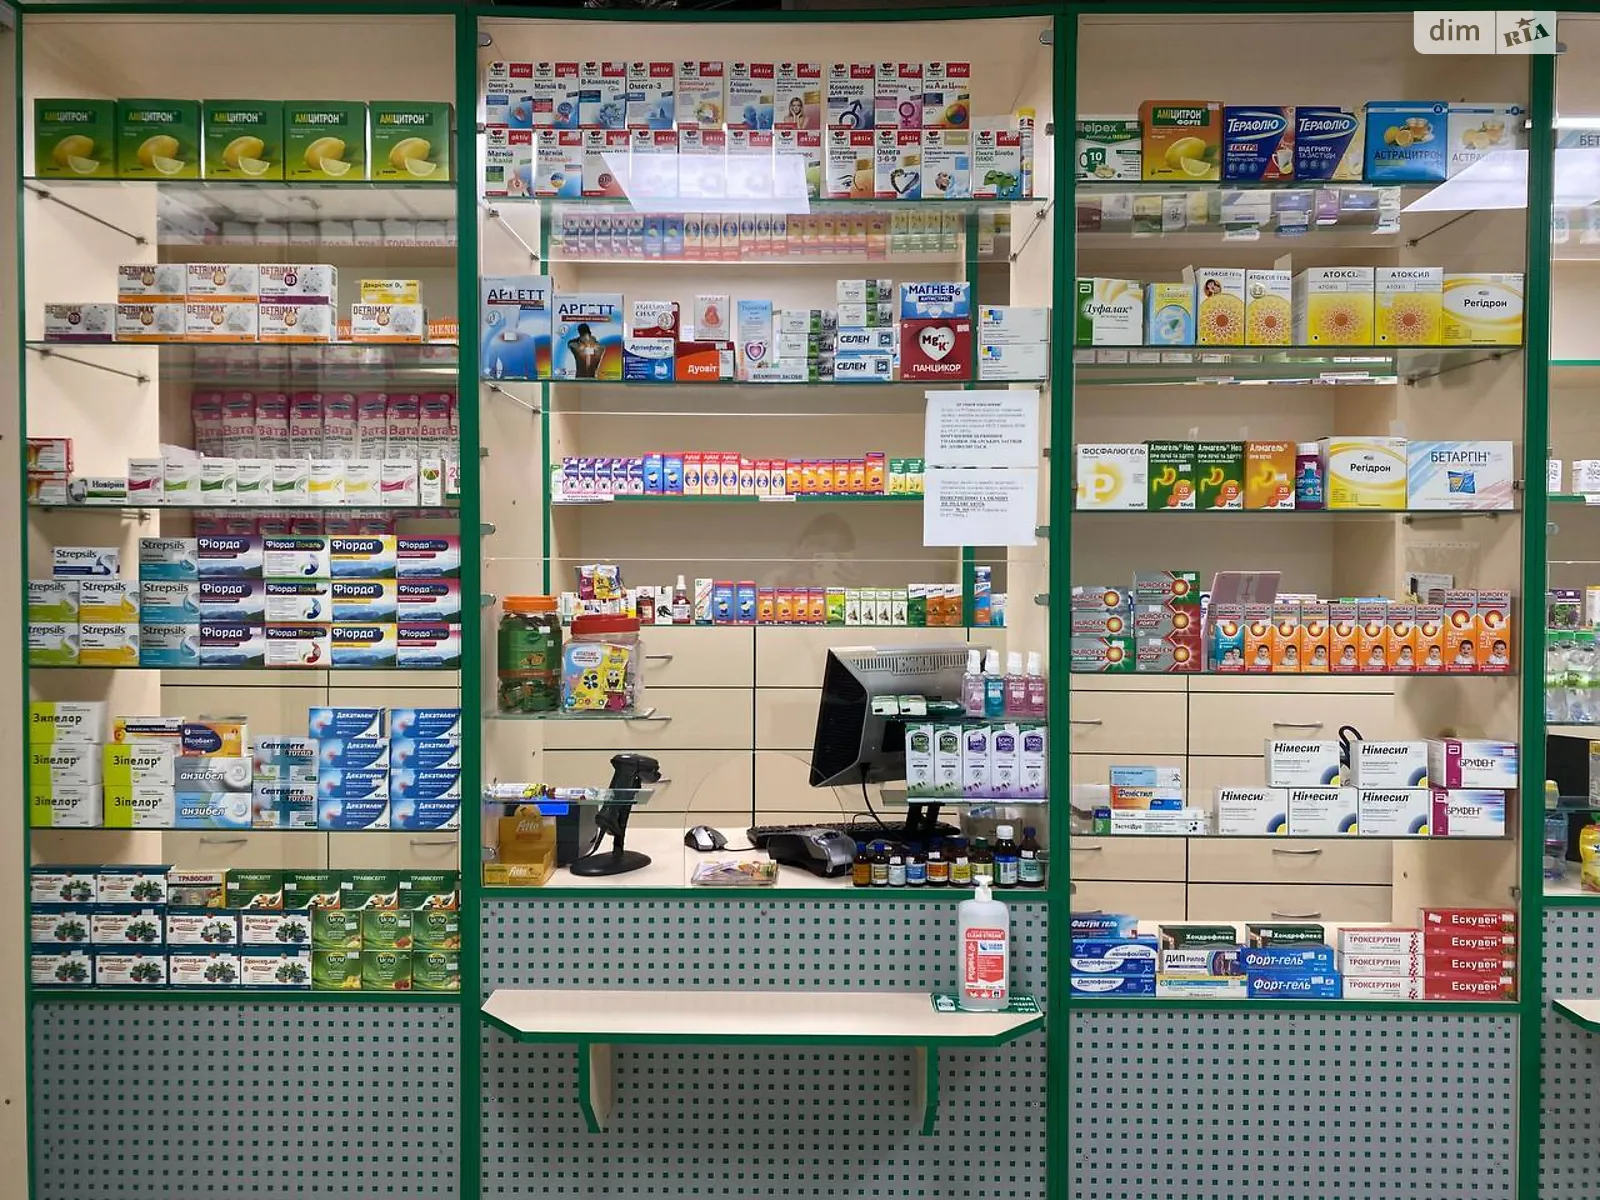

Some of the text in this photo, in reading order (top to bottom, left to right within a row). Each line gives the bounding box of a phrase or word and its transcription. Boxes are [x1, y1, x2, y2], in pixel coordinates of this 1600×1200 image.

[295, 113, 340, 123] АМІЦИТРОН
[379, 114, 425, 124] АМІЦИТРОН
[1157, 109, 1202, 120] АМІЦИТРОН
[1078, 124, 1116, 135] elpex
[1228, 119, 1279, 132] ТЕРАФЛЮ
[1299, 119, 1350, 132] ТЕРАФЛЮ
[1089, 152, 1102, 161] 10
[1374, 149, 1441, 162] АСТРАЦИТРОН
[188, 265, 227, 274] DETRIMAX
[261, 267, 299, 275] DETRIMAX
[1464, 298, 1507, 308] Регідрон
[187, 305, 225, 314] DETRIMAX
[261, 306, 299, 315] DETRIMAX
[353, 306, 391, 315] DETRIMAX
[1084, 304, 1129, 319] Дуфалак
[840, 335, 870, 344] СЕЛЕН
[688, 365, 717, 374] Дуовіт
[837, 362, 866, 371] СЕЛЕН
[913, 363, 961, 372] ПАНЦИКОР
[390, 425, 418, 436] Вата
[1249, 444, 1284, 453] Алмагель
[1431, 451, 1488, 463] БЕТАРГІН
[1350, 464, 1391, 473] Регідрон
[92, 481, 125, 489] Новірин
[142, 540, 185, 550] Strepsils
[200, 539, 240, 551] Фіорда
[265, 540, 295, 549] Фіорда
[332, 540, 373, 551] Фіорда
[400, 541, 430, 550] Фіорда
[57, 549, 97, 560] Strepsils
[82, 582, 126, 592] Strepsils
[144, 584, 188, 594] Strepsils
[202, 583, 243, 596] Фіорда
[268, 585, 297, 594] Фіорда
[333, 583, 374, 595] Фіорда
[400, 585, 430, 594] Фіорда
[29, 626, 65, 635] trepsils
[83, 625, 126, 635] Strepsils
[142, 626, 185, 636] Strepsils
[202, 627, 243, 639] Фіорда
[268, 629, 297, 638] Фіорда
[333, 628, 374, 639] Фіорда
[400, 629, 431, 639] Фіорда
[1274, 743, 1320, 753] Німесил
[1362, 745, 1408, 754] Німесил
[34, 756, 77, 765] Зіпелор
[113, 756, 157, 767] Зіпелор
[181, 771, 224, 780] анзибел
[34, 797, 78, 807] Зіпелор
[1292, 792, 1338, 802] Німесил
[1362, 792, 1409, 802] Німесил
[115, 797, 158, 808] Зіпелор
[182, 807, 224, 816] анзибел
[1452, 915, 1497, 925] Ескувен
[1452, 938, 1497, 947] Ескувен
[1166, 954, 1185, 964] ДИП
[1246, 953, 1303, 965] Форт-гель
[1452, 960, 1497, 969] Ескувен
[1254, 978, 1311, 991] Форт-гель
[1452, 982, 1497, 992] Ескувен
